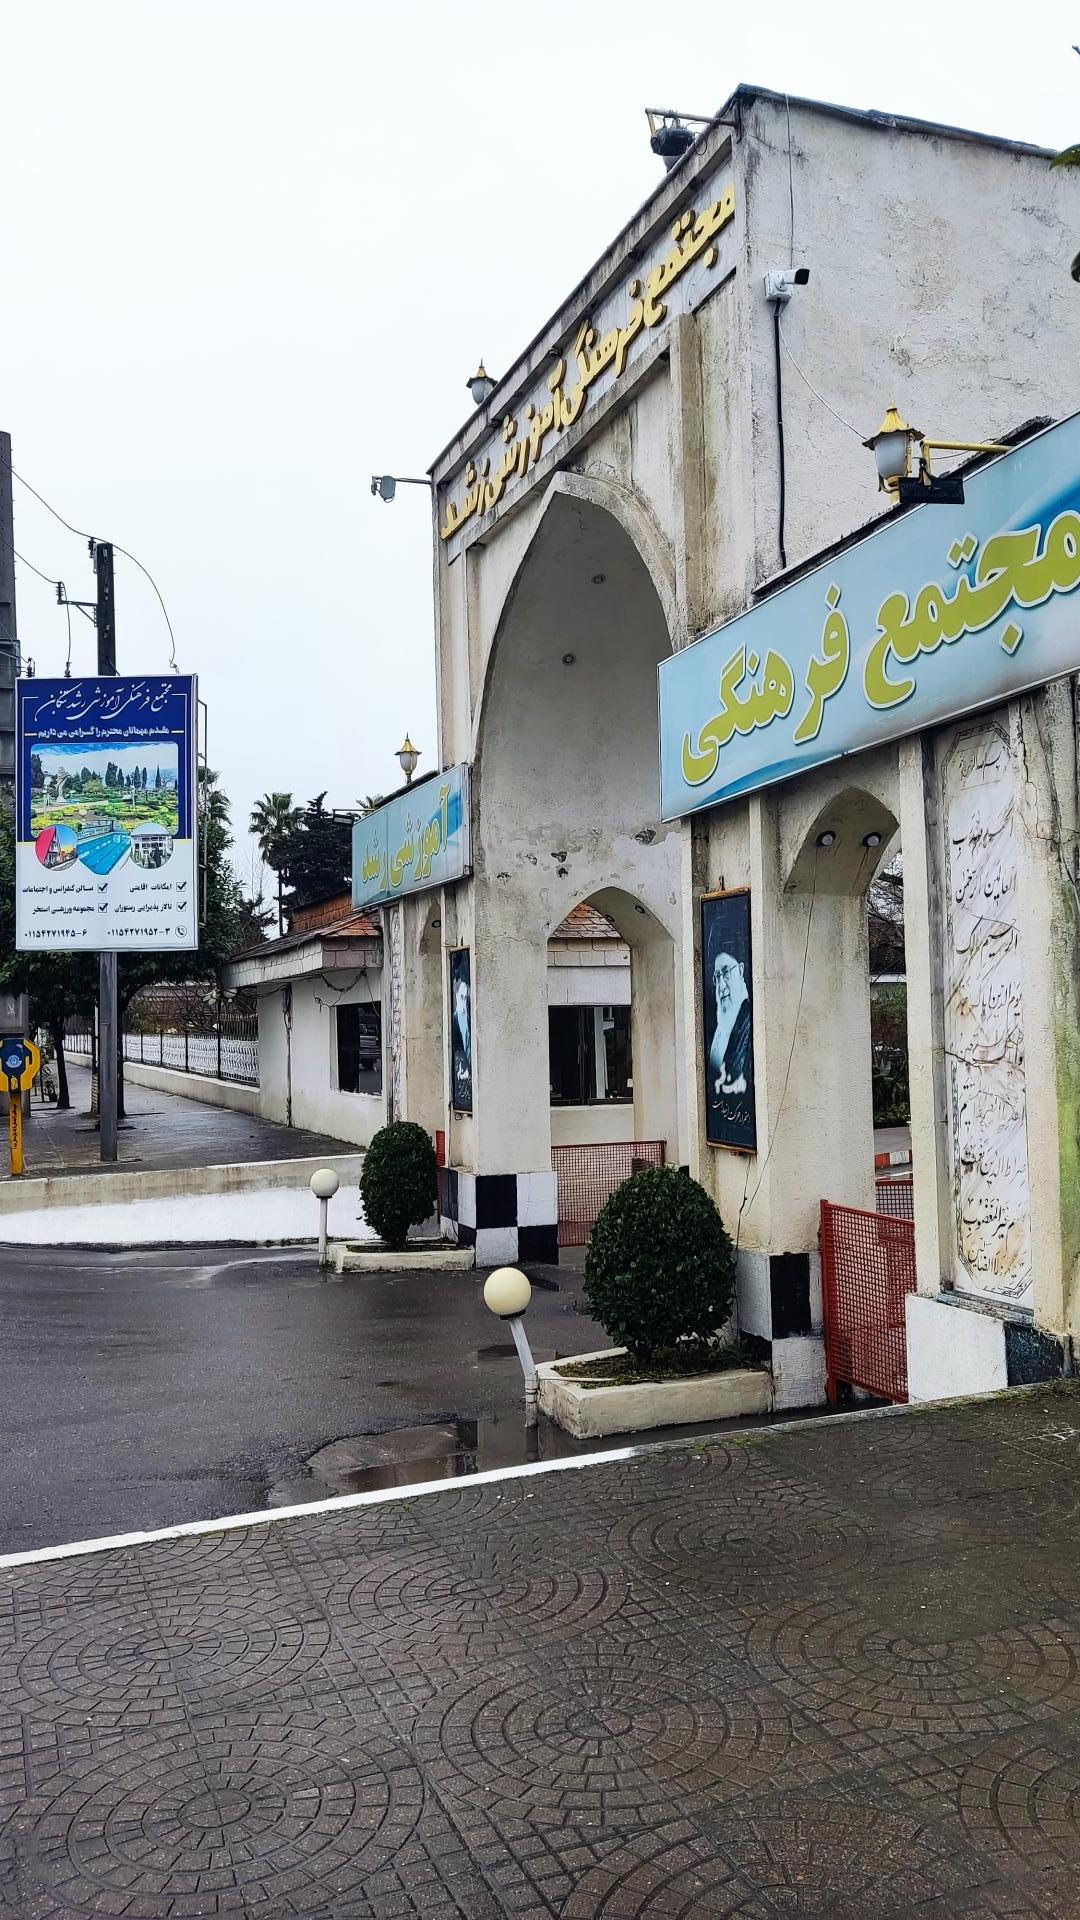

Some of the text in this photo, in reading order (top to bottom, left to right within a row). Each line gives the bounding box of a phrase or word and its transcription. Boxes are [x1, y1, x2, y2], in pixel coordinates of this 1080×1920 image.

[439, 182, 736, 541] مجتمع فرهنگی آموزشی رشد
[680, 508, 1080, 786] مجتمع فرهنگی
[34, 681, 173, 722] مجتمع فرهنگی آموزشی رشد تنکابن
[68, 726, 96, 738] گرامی
[101, 726, 123, 737] محترم
[362, 784, 451, 892] آموزشی رشد
[22, 885, 49, 893] اجتماعات
[53, 884, 76, 894] کنفرانس
[75, 884, 94, 893] سالن
[151, 882, 172, 890] امکانات
[32, 905, 95, 915] مجموعه ورزشی استخر
[114, 903, 136, 913] رستوران
[137, 903, 159, 913] پذیرایی
